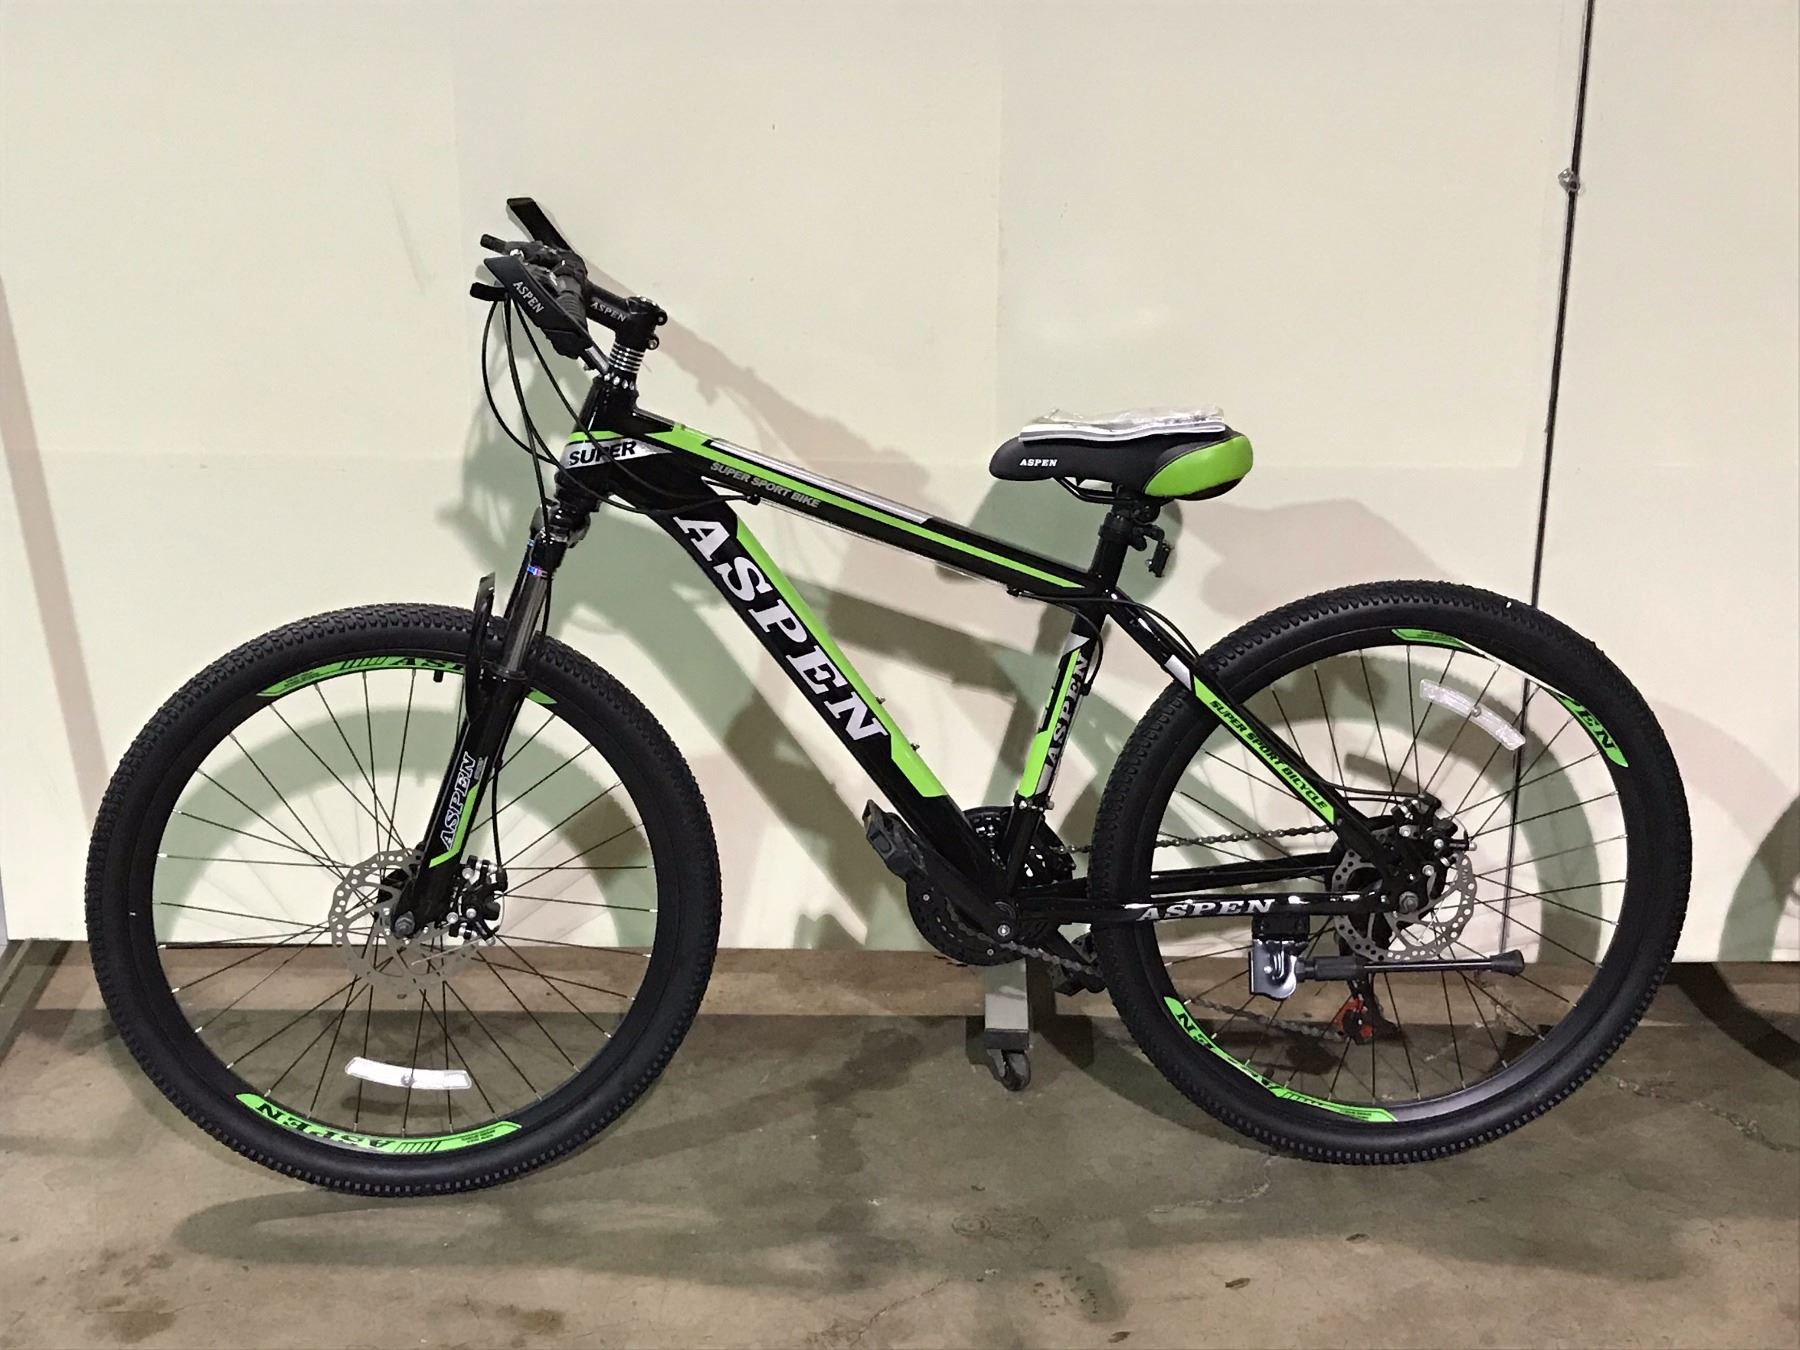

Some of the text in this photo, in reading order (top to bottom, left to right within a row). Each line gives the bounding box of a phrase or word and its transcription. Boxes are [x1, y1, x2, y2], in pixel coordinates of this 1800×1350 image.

[513, 281, 544, 314] ASPEN
[590, 302, 627, 323] ASPEN
[1019, 458, 1057, 467] ASPEN
[710, 462, 821, 508] SUPER SPORT BIKE
[673, 516, 888, 741] ASPEN
[1209, 700, 1328, 809] SUPER SPORT BICYCLE
[440, 751, 476, 851] ASPEN
[1136, 899, 1275, 921] ASPEN
